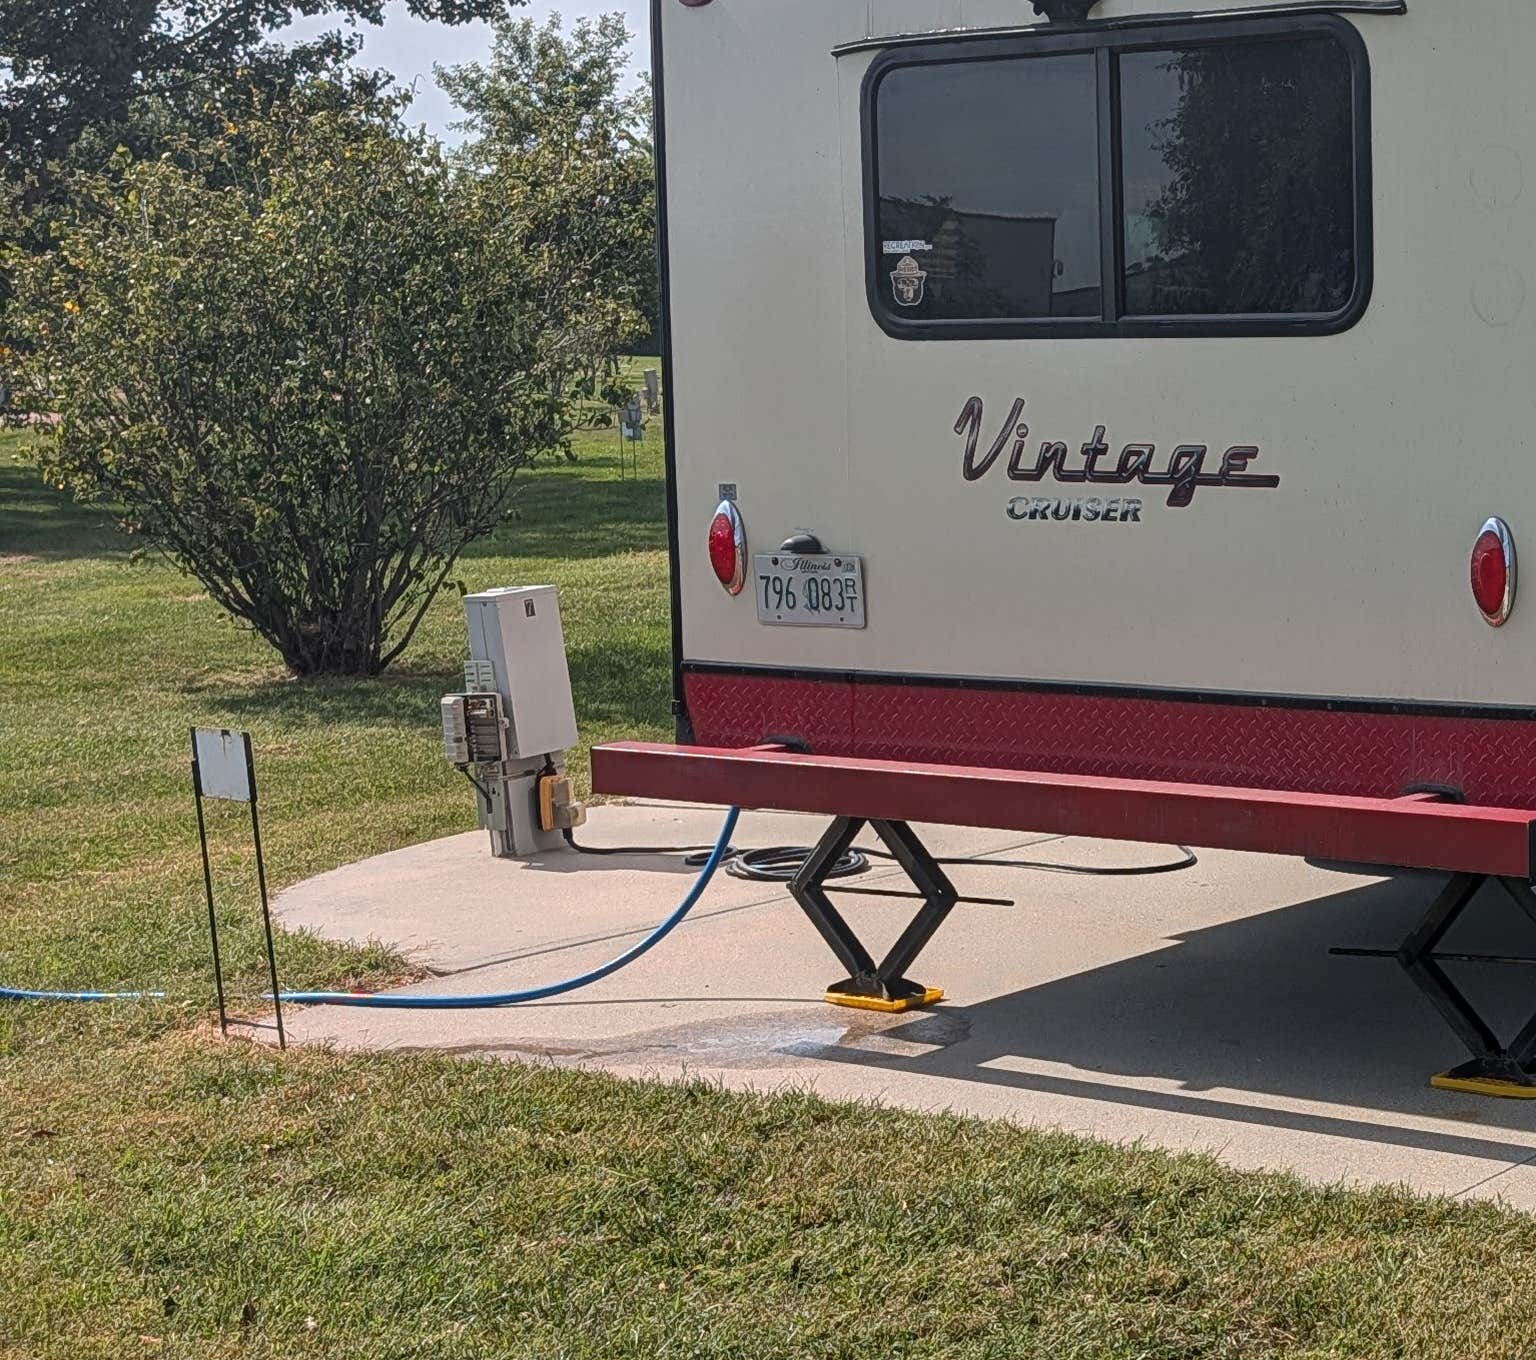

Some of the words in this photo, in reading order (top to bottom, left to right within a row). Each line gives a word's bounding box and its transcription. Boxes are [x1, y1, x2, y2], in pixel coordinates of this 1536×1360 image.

[953, 396, 1281, 508] Vintage
[1006, 496, 1143, 522] CRUISER
[780, 558, 831, 571] Illinois
[760, 575, 797, 610] 796
[808, 577, 845, 611] 083
